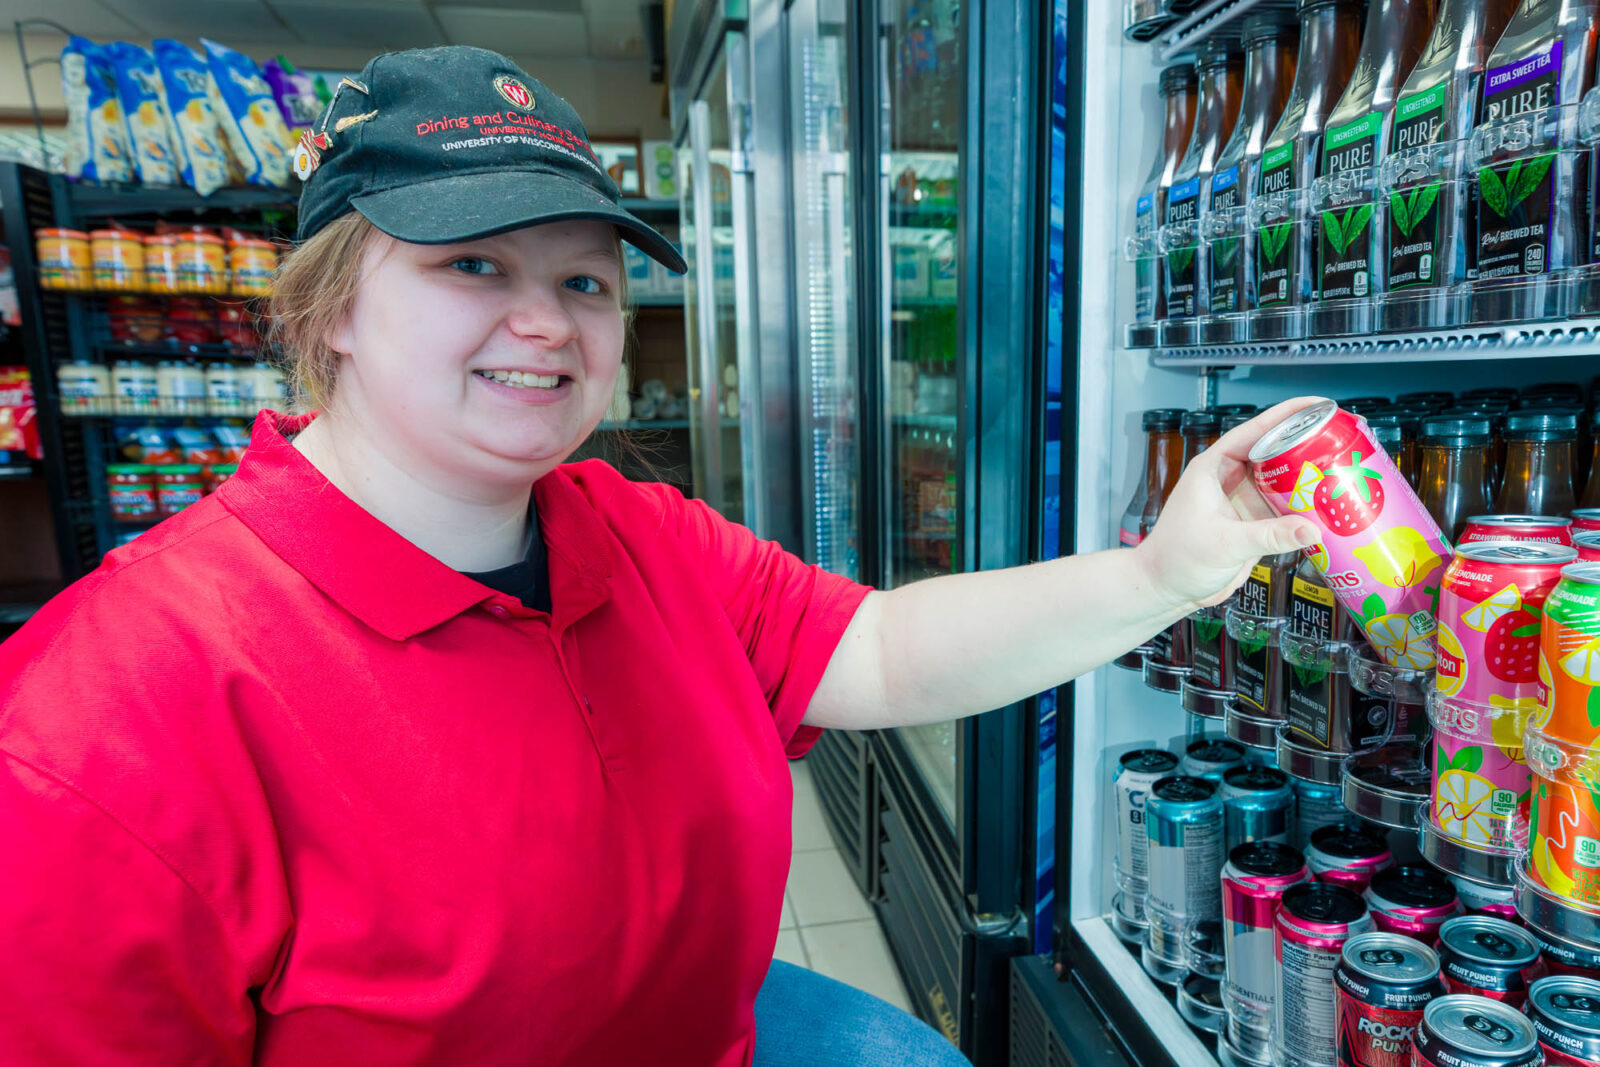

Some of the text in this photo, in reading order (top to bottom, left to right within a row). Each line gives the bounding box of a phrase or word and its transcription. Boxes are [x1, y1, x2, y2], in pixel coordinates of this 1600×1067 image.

[1490, 54, 1551, 87] EXTRA SWEET TEA
[504, 85, 526, 105] W
[1488, 82, 1551, 122] PURE
[416, 116, 470, 136] Dining
[473, 112, 503, 126] and
[506, 111, 564, 137] Culinary
[480, 125, 537, 136] UNIVERSITY
[1333, 121, 1369, 142] UNSWEETENED
[1399, 116, 1438, 149] PURE
[442, 136, 501, 151] UNIVERSITY
[504, 135, 519, 144] OF
[1330, 143, 1371, 175] PURE
[1264, 168, 1290, 194] PURE
[1215, 189, 1236, 212] PURE
[1170, 201, 1195, 222] PURE
[1500, 227, 1530, 242] BREWED
[1530, 224, 1544, 235] TEA
[1404, 243, 1423, 255] BREWED
[1423, 241, 1432, 251] TEA
[1527, 248, 1541, 261] 240
[1337, 261, 1356, 271] BREWED
[1357, 259, 1367, 268] TEA
[1260, 464, 1289, 479] LEMONADE
[1454, 569, 1493, 583] LEMONADE
[1239, 581, 1267, 603] URE
[1304, 583, 1319, 595] LEMON
[1350, 589, 1368, 598] TEA
[1238, 594, 1266, 617] LEAF
[1294, 600, 1329, 629] PURE
[1293, 619, 1329, 645] LEAF
[1498, 792, 1512, 803] 90
[1581, 840, 1596, 854] 90
[1572, 868, 1580, 879] 16
[1570, 889, 1585, 901] 473
[1313, 953, 1336, 961] Facts
[1548, 946, 1575, 960] PUNCH
[1449, 962, 1470, 976] FRUIT
[1469, 971, 1497, 983] PUNCH
[1347, 979, 1370, 996] PUNCH
[1384, 992, 1432, 1002] FRUIT PUNCH
[1534, 1020, 1583, 1049] FRUIT PUNCH
[1371, 1038, 1413, 1054] PUNC
[1437, 1050, 1461, 1067] FRUIT
